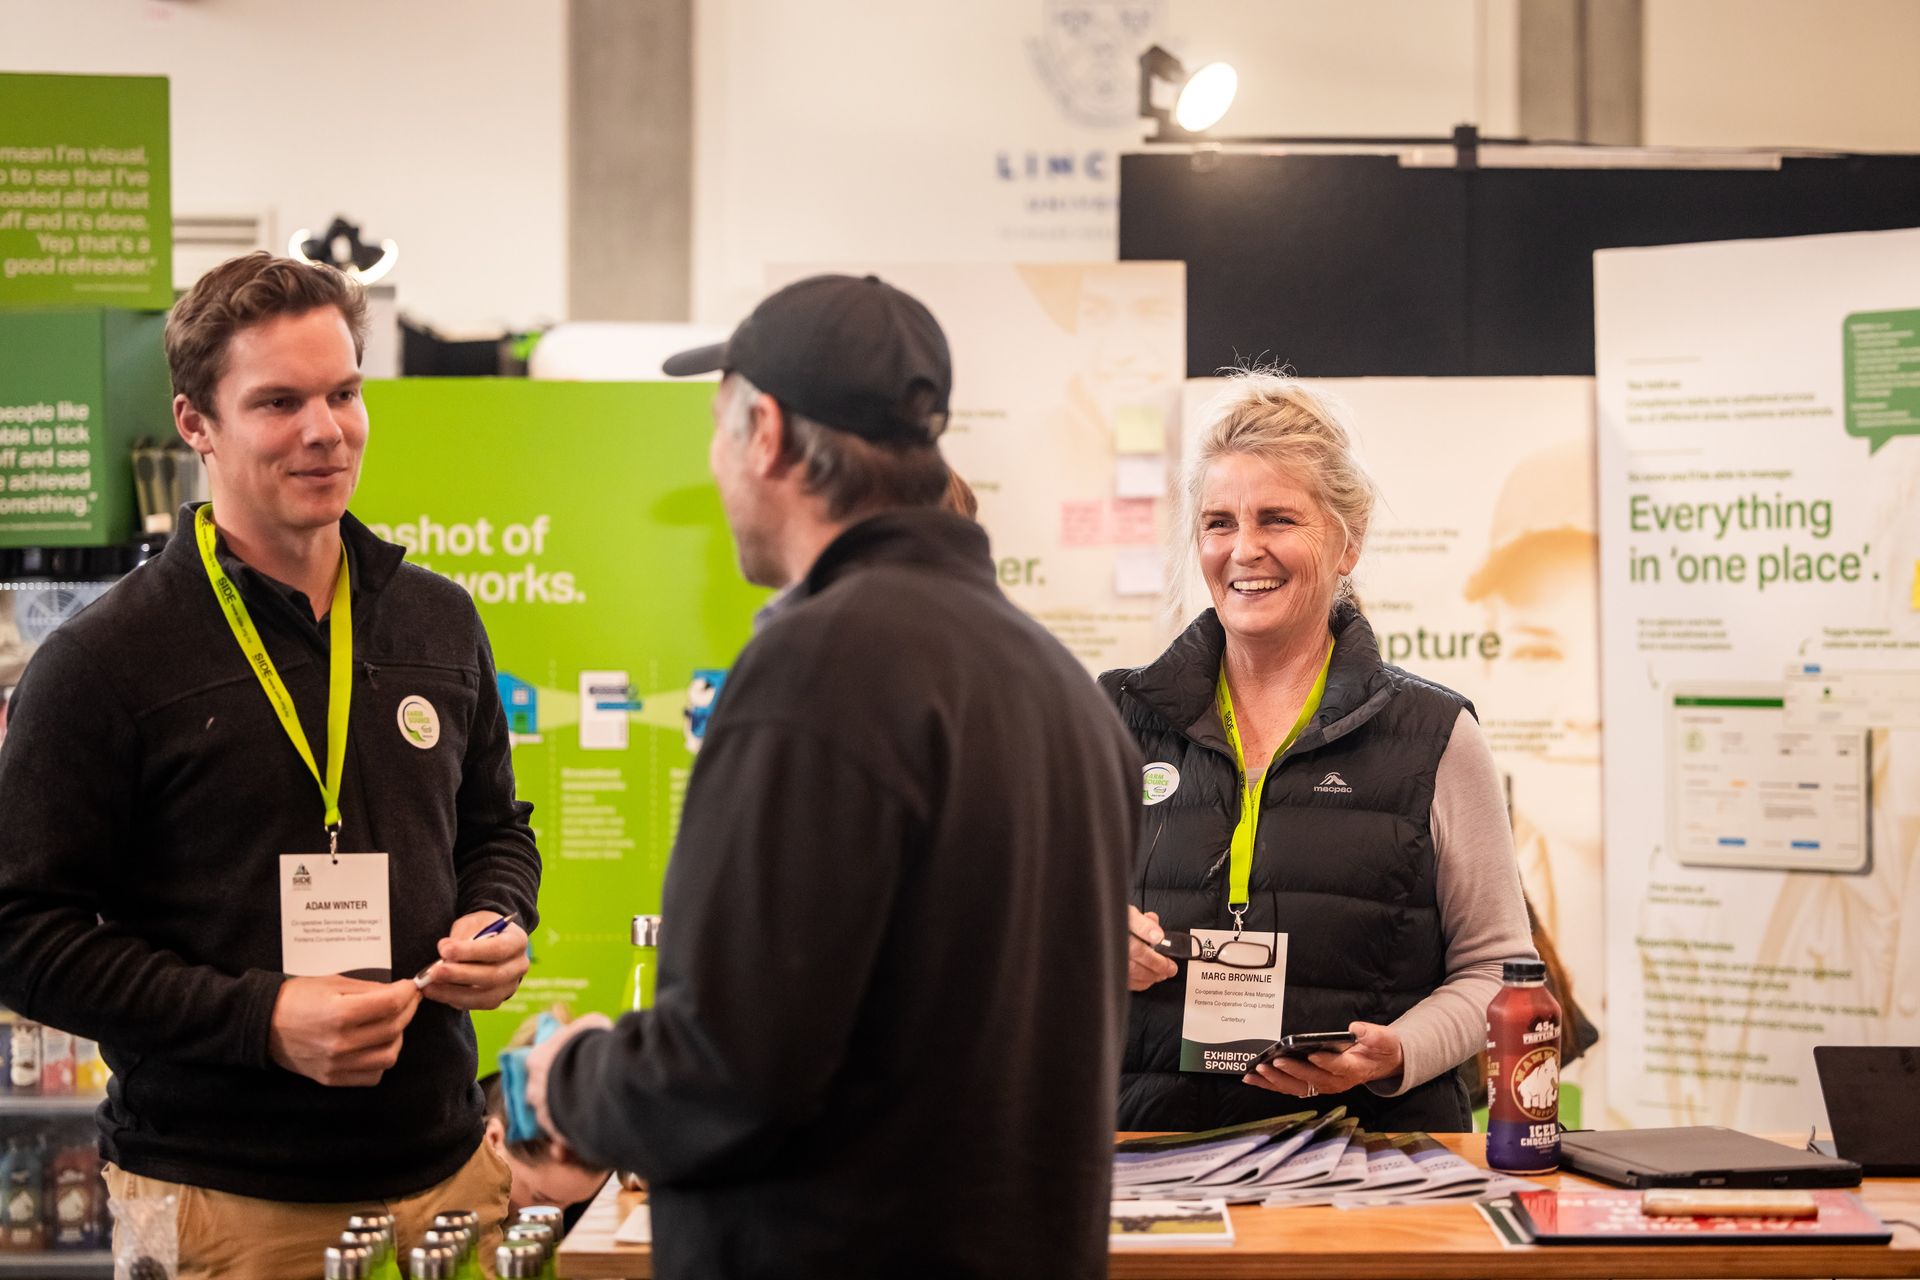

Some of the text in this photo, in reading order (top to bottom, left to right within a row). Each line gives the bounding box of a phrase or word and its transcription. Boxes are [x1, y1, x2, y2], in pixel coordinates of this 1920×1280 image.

[1628, 493, 1833, 540] Everything
[502, 514, 550, 556] of
[1629, 546, 1662, 583] in
[1669, 546, 1747, 584] 'one
[218, 577, 237, 604] SIDE
[254, 652, 273, 678] SIDE
[305, 900, 368, 911] ADAM WINTER
[1201, 971, 1273, 983] MARG BROWNLIE
[1220, 1016, 1246, 1024] Canterbury
[1529, 1123, 1556, 1138] ICED
